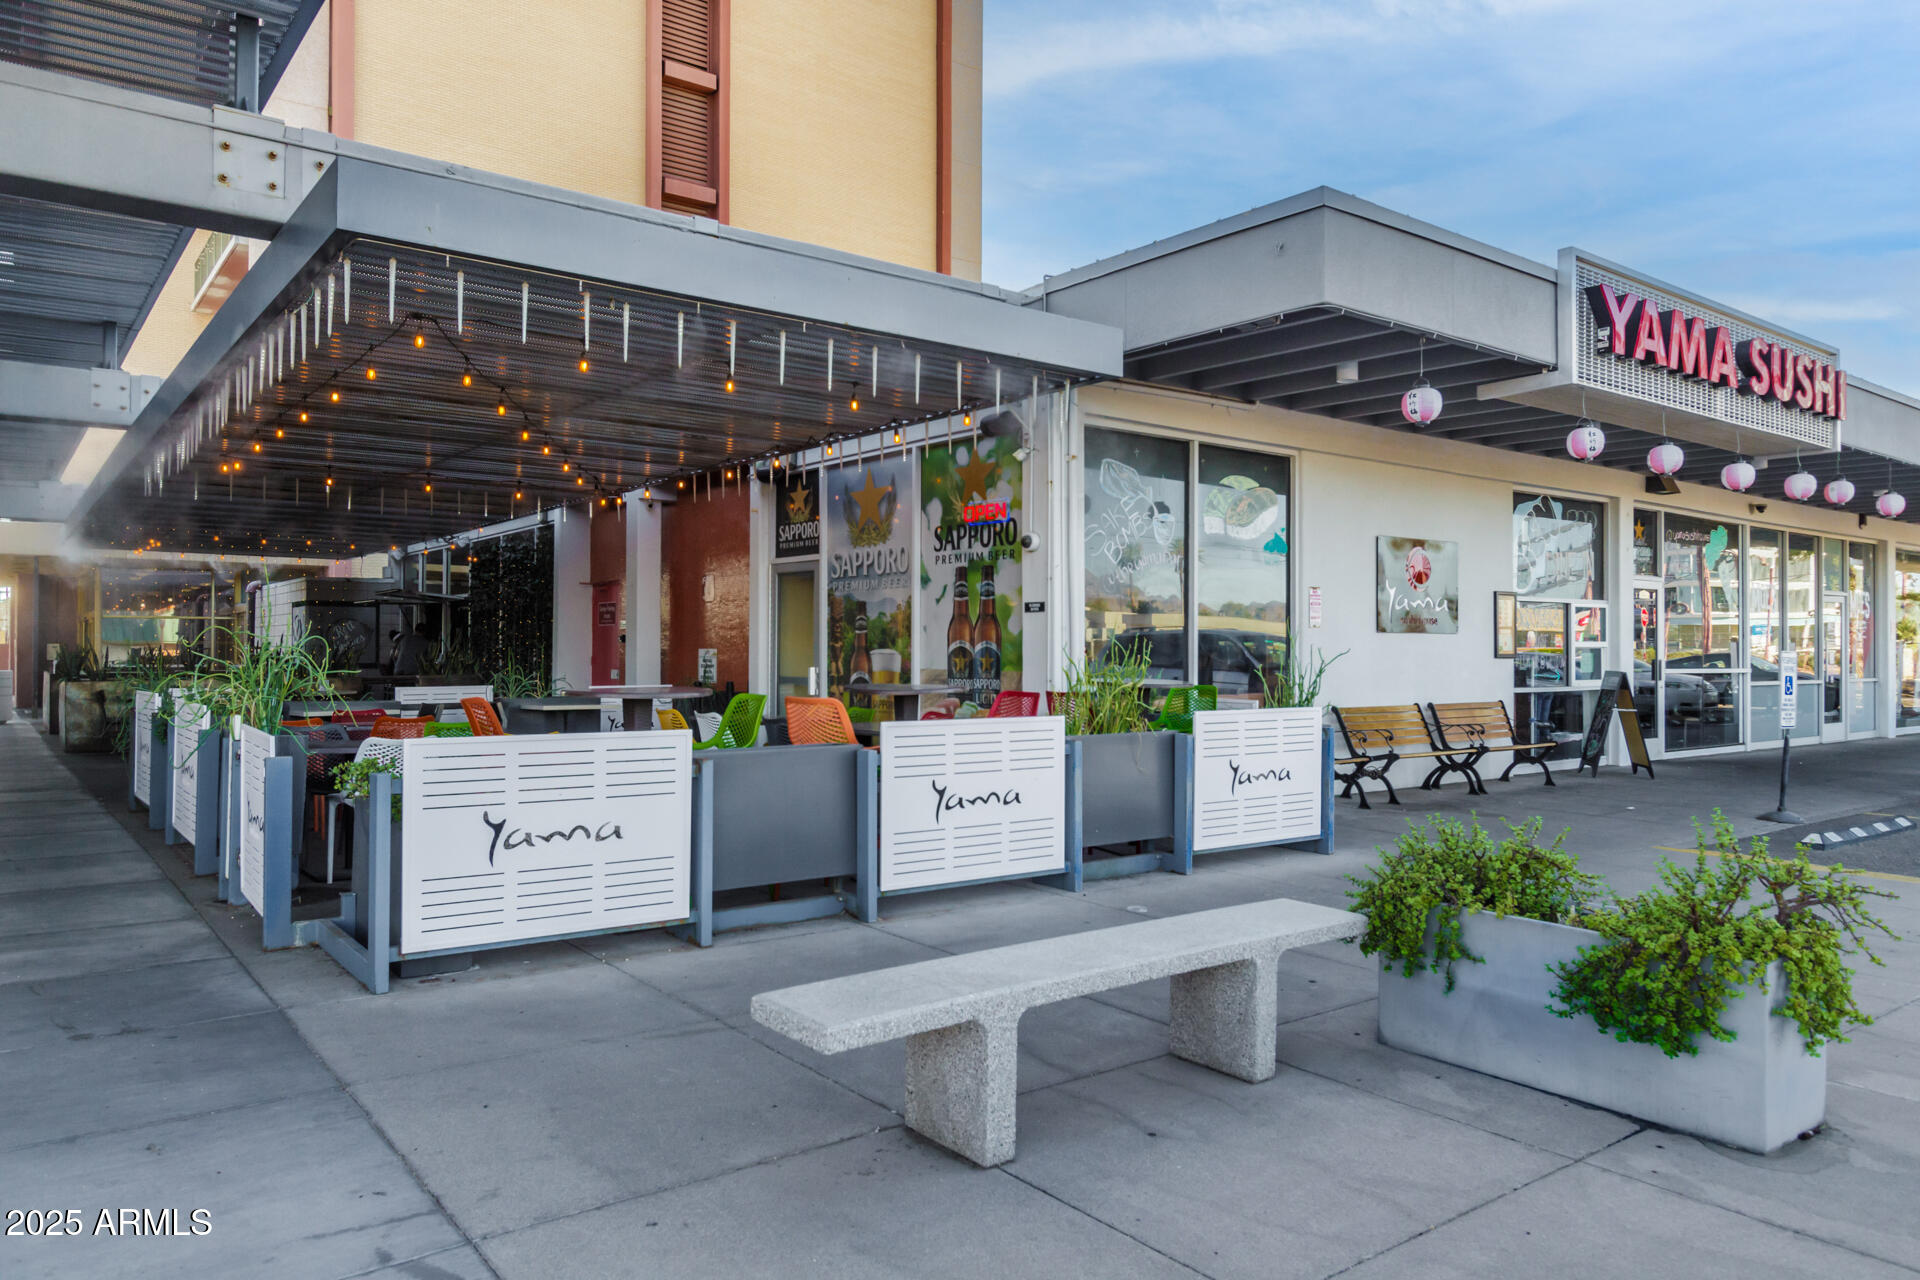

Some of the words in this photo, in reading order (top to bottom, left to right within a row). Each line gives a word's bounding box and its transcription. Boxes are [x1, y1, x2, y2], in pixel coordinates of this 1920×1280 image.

[1600, 283, 1738, 389] YAMA
[1749, 337, 1847, 421] SUSHI
[963, 501, 1007, 523] OPEN
[779, 520, 819, 542] SAPPORO
[779, 541, 804, 550] PREMIUM
[805, 538, 819, 548] BEER
[933, 517, 1018, 552] SAPPORO
[831, 546, 910, 579] SAPPORO
[935, 551, 984, 566] PREMIUM
[988, 549, 1016, 561] BEER
[833, 579, 879, 593] PREMIUM
[881, 576, 911, 589] BEER
[1386, 578, 1449, 624] Yama
[1229, 759, 1291, 797] Yama
[931, 779, 1022, 825] Yama
[482, 810, 624, 868] Yama
